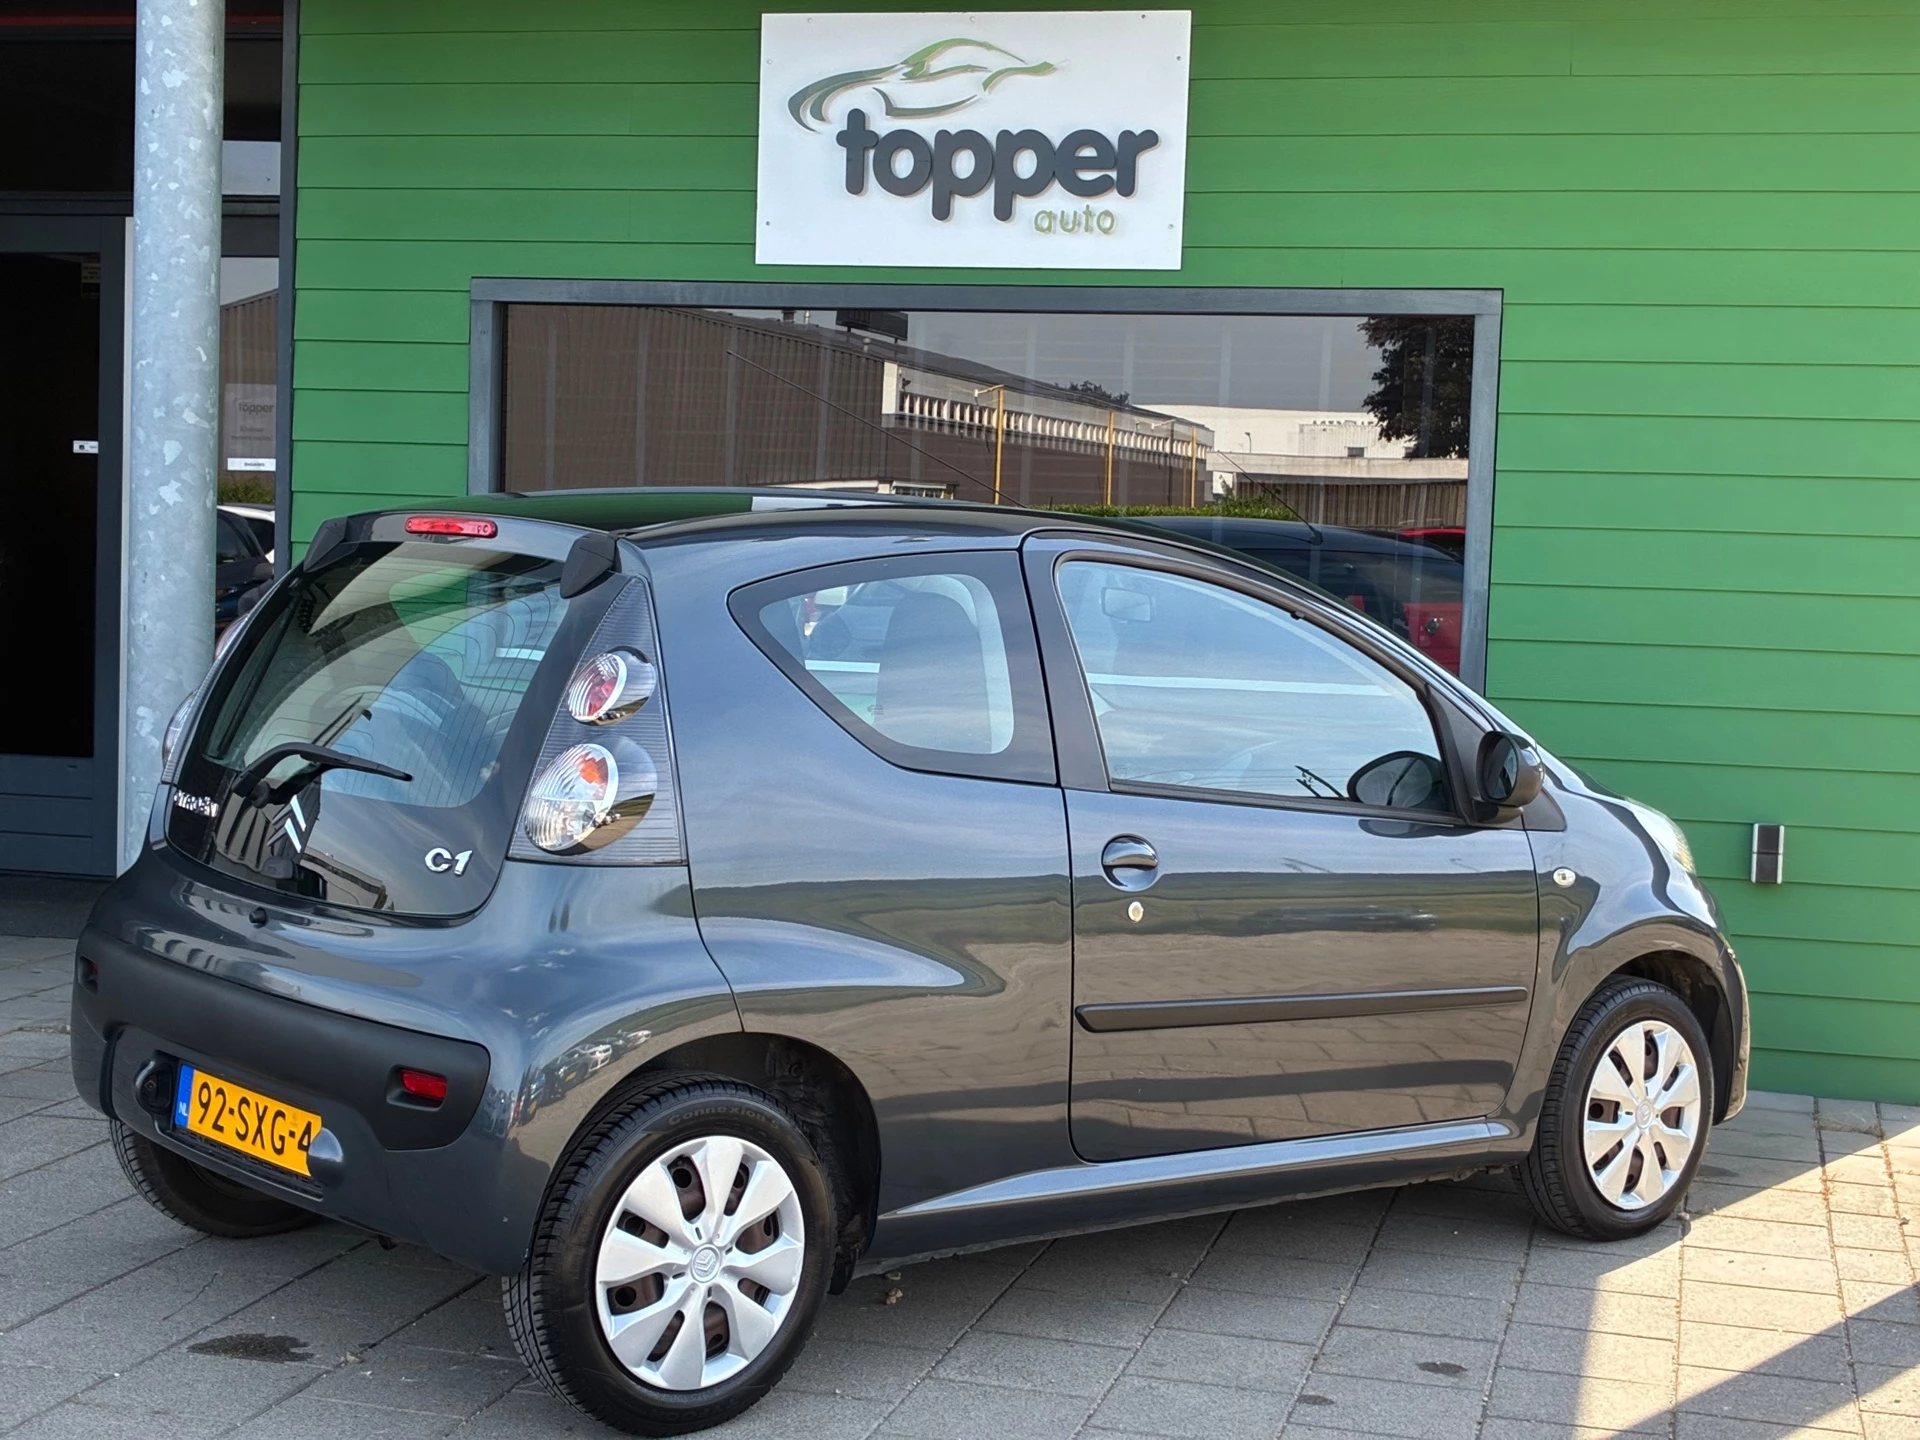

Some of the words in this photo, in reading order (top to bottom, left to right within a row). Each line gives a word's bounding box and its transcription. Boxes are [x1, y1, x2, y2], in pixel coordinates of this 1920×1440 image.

[836, 108, 1159, 221] topper
[1034, 204, 1116, 234] auto
[425, 847, 473, 876] C1
[178, 1101, 188, 1117] NL
[198, 1081, 312, 1155] 92-SXG-4
